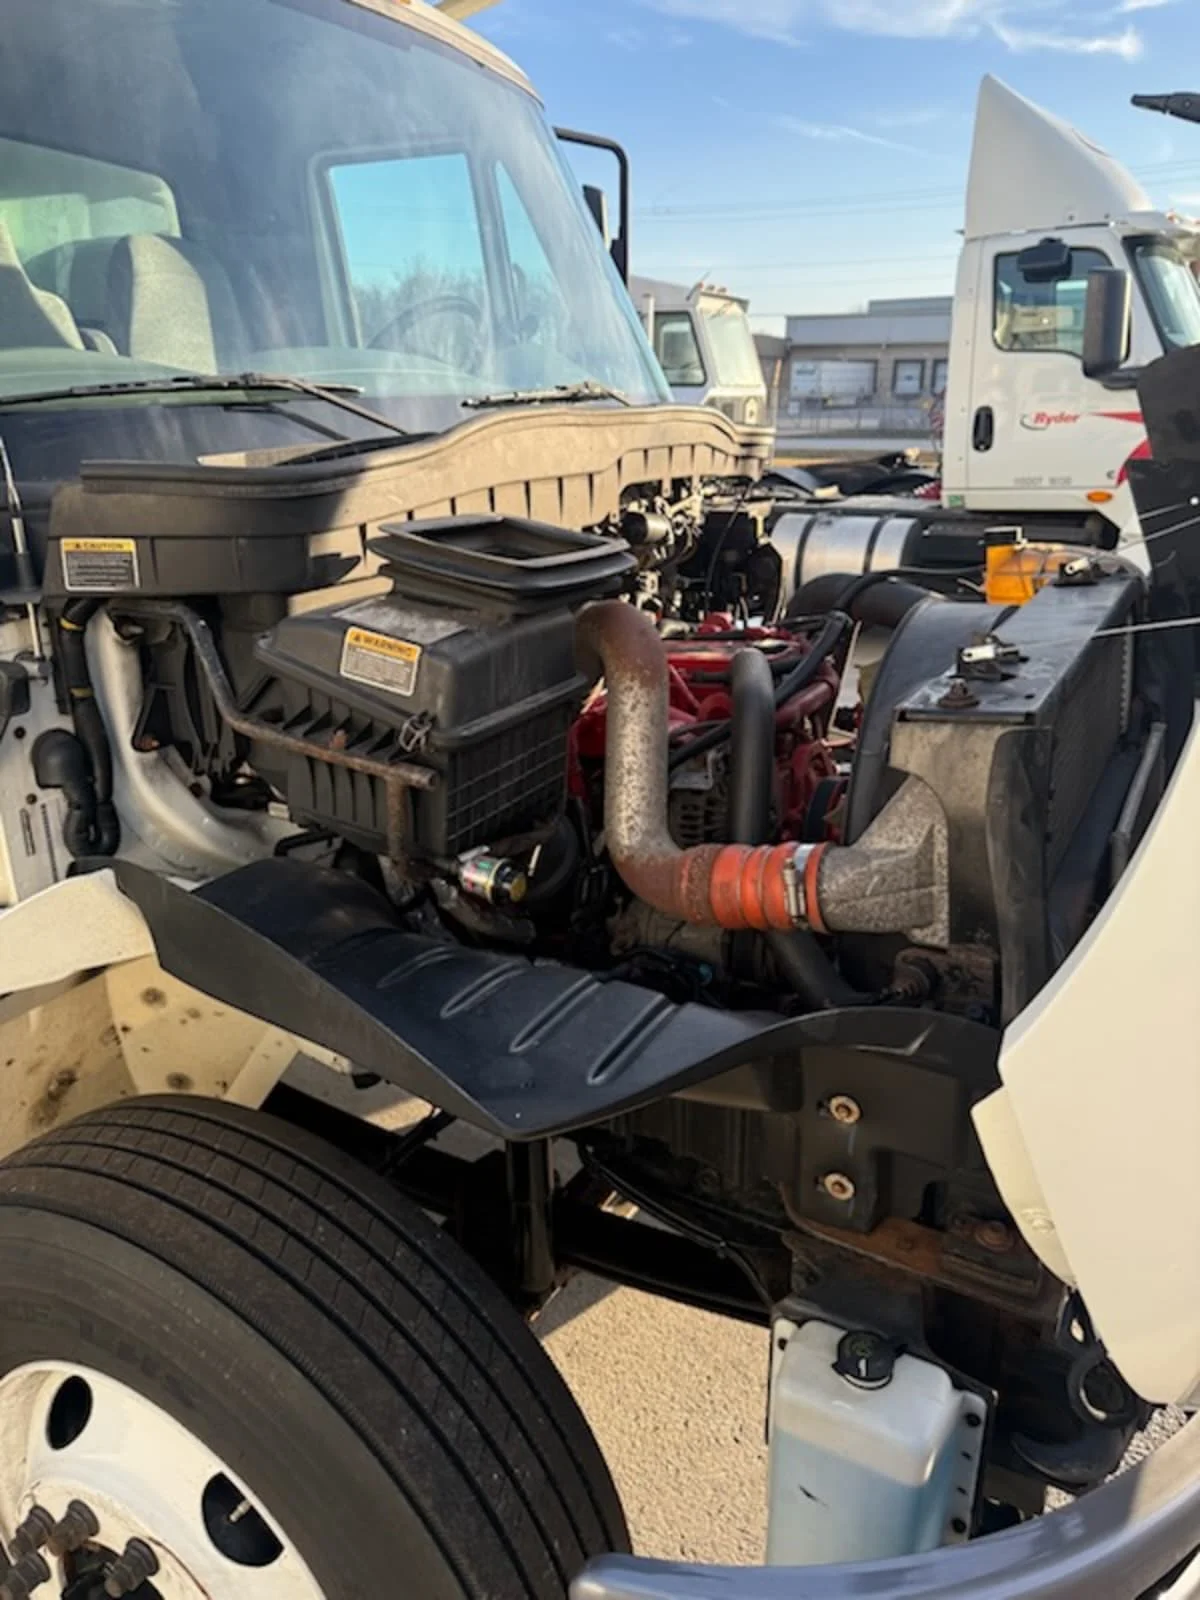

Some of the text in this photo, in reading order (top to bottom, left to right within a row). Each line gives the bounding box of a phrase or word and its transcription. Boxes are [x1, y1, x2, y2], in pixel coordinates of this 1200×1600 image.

[1033, 411, 1080, 426] Ryder
[83, 541, 124, 550] CAUTION
[363, 633, 413, 657] WARNING
